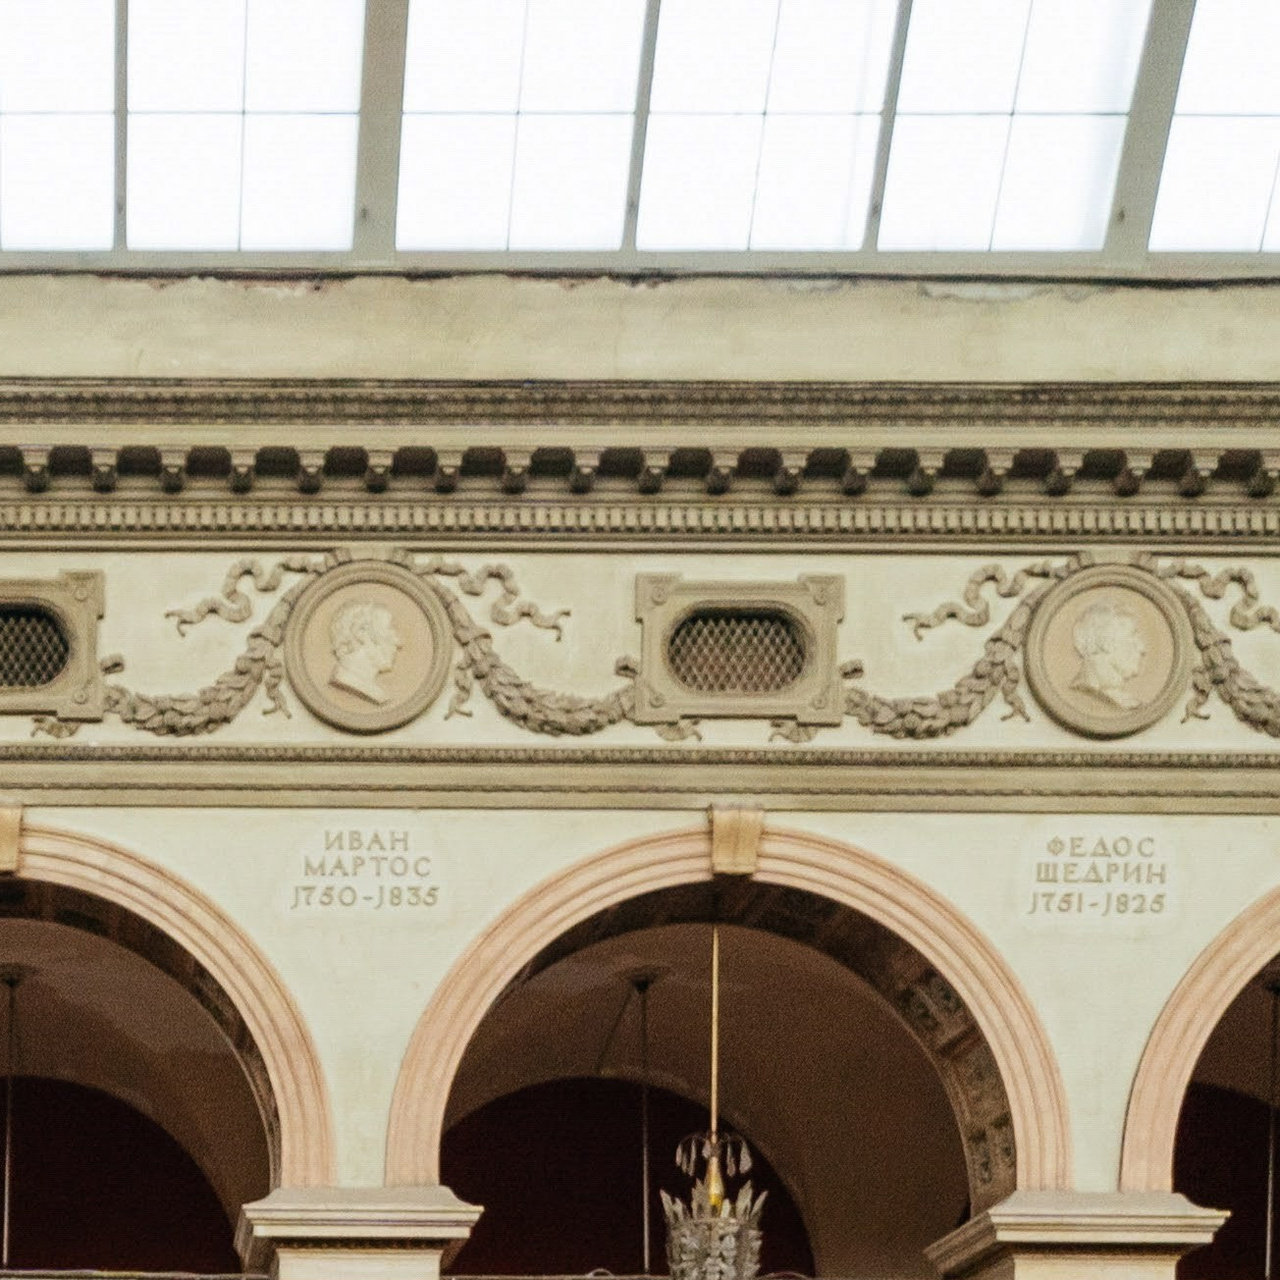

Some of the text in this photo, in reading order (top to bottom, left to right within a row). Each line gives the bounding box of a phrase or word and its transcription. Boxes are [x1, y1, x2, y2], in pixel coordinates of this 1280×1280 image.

[324, 829, 410, 851] ИВАН
[1046, 835, 1155, 858] ФЕДОС
[303, 855, 432, 878] МАРТОС
